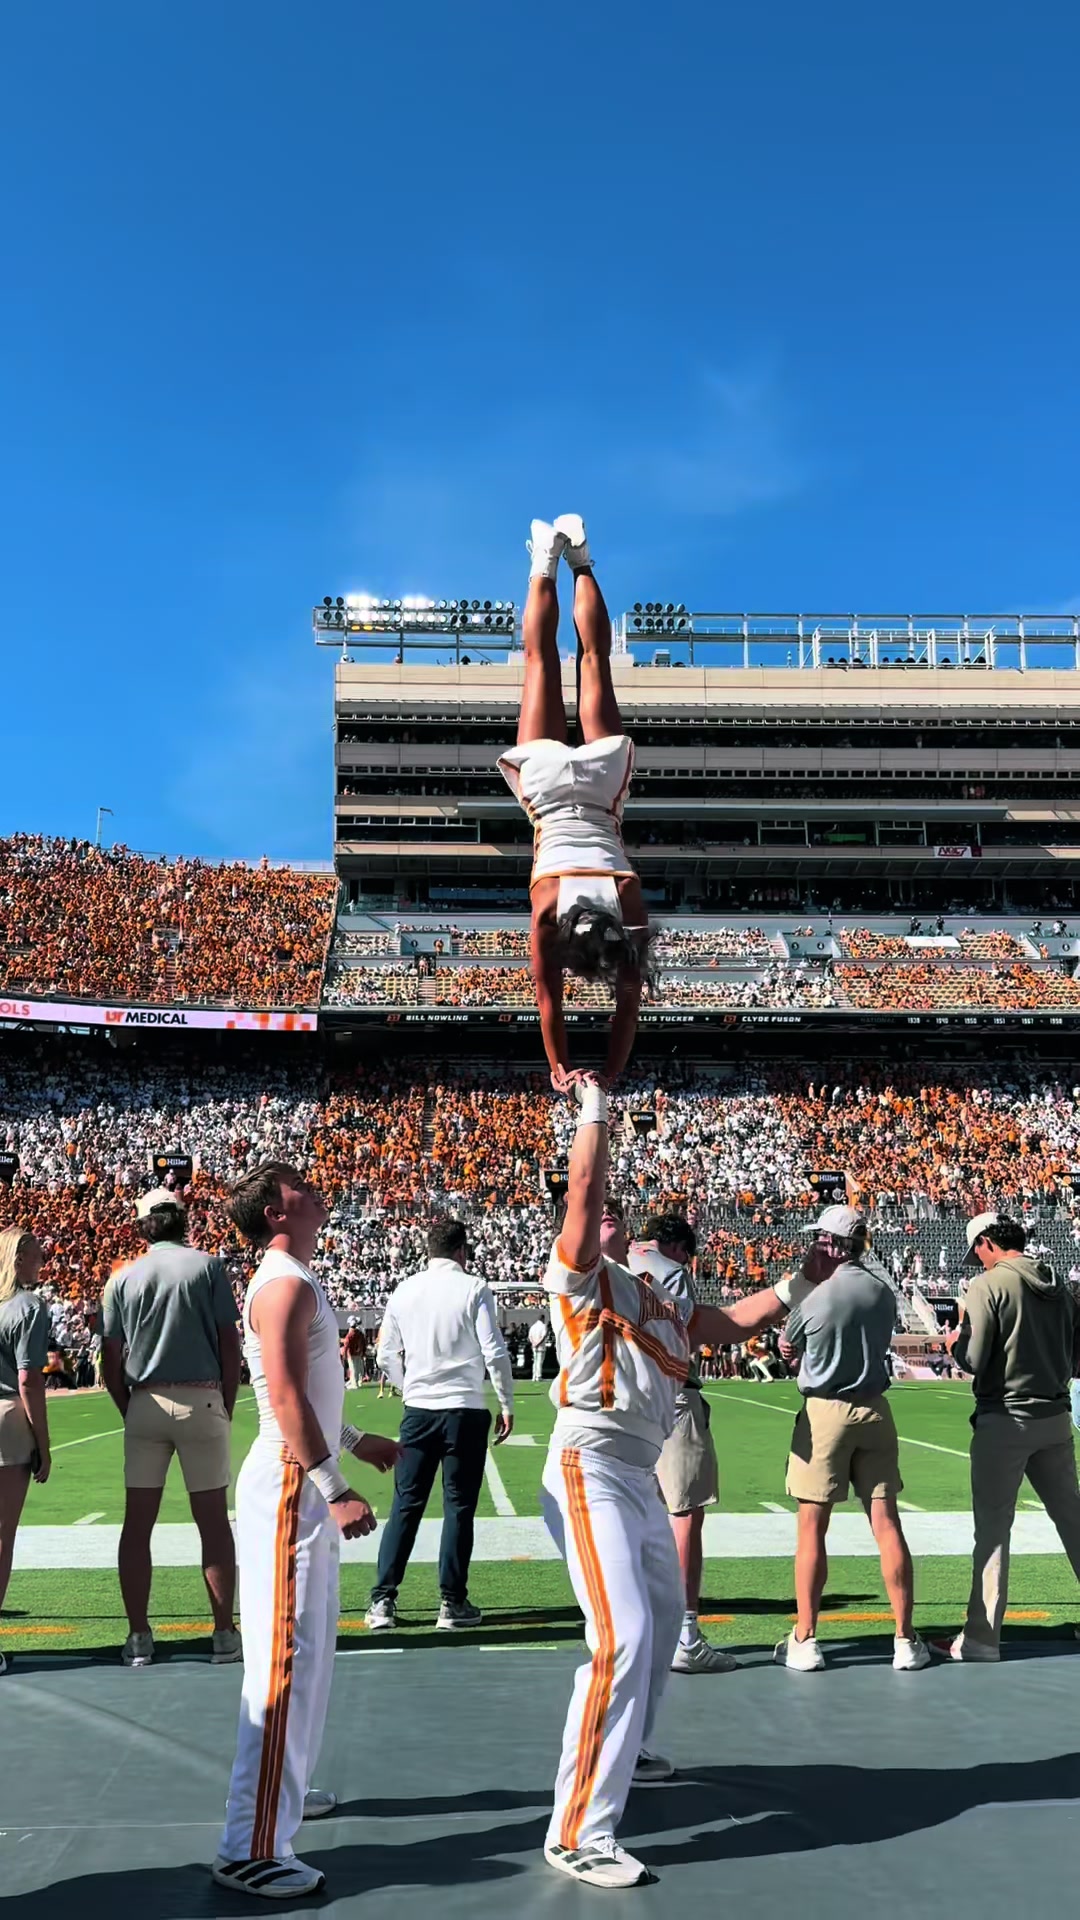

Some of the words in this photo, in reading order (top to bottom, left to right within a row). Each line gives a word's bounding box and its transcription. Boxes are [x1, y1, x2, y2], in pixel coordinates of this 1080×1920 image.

[0, 1002, 30, 1016] OLS
[125, 1011, 188, 1025] MEDICAL
[516, 1014, 541, 1022] RUDY
[638, 1014, 657, 1022] LLIS
[659, 1014, 694, 1022] TUCKER
[934, 1303, 954, 1311] Hiller
